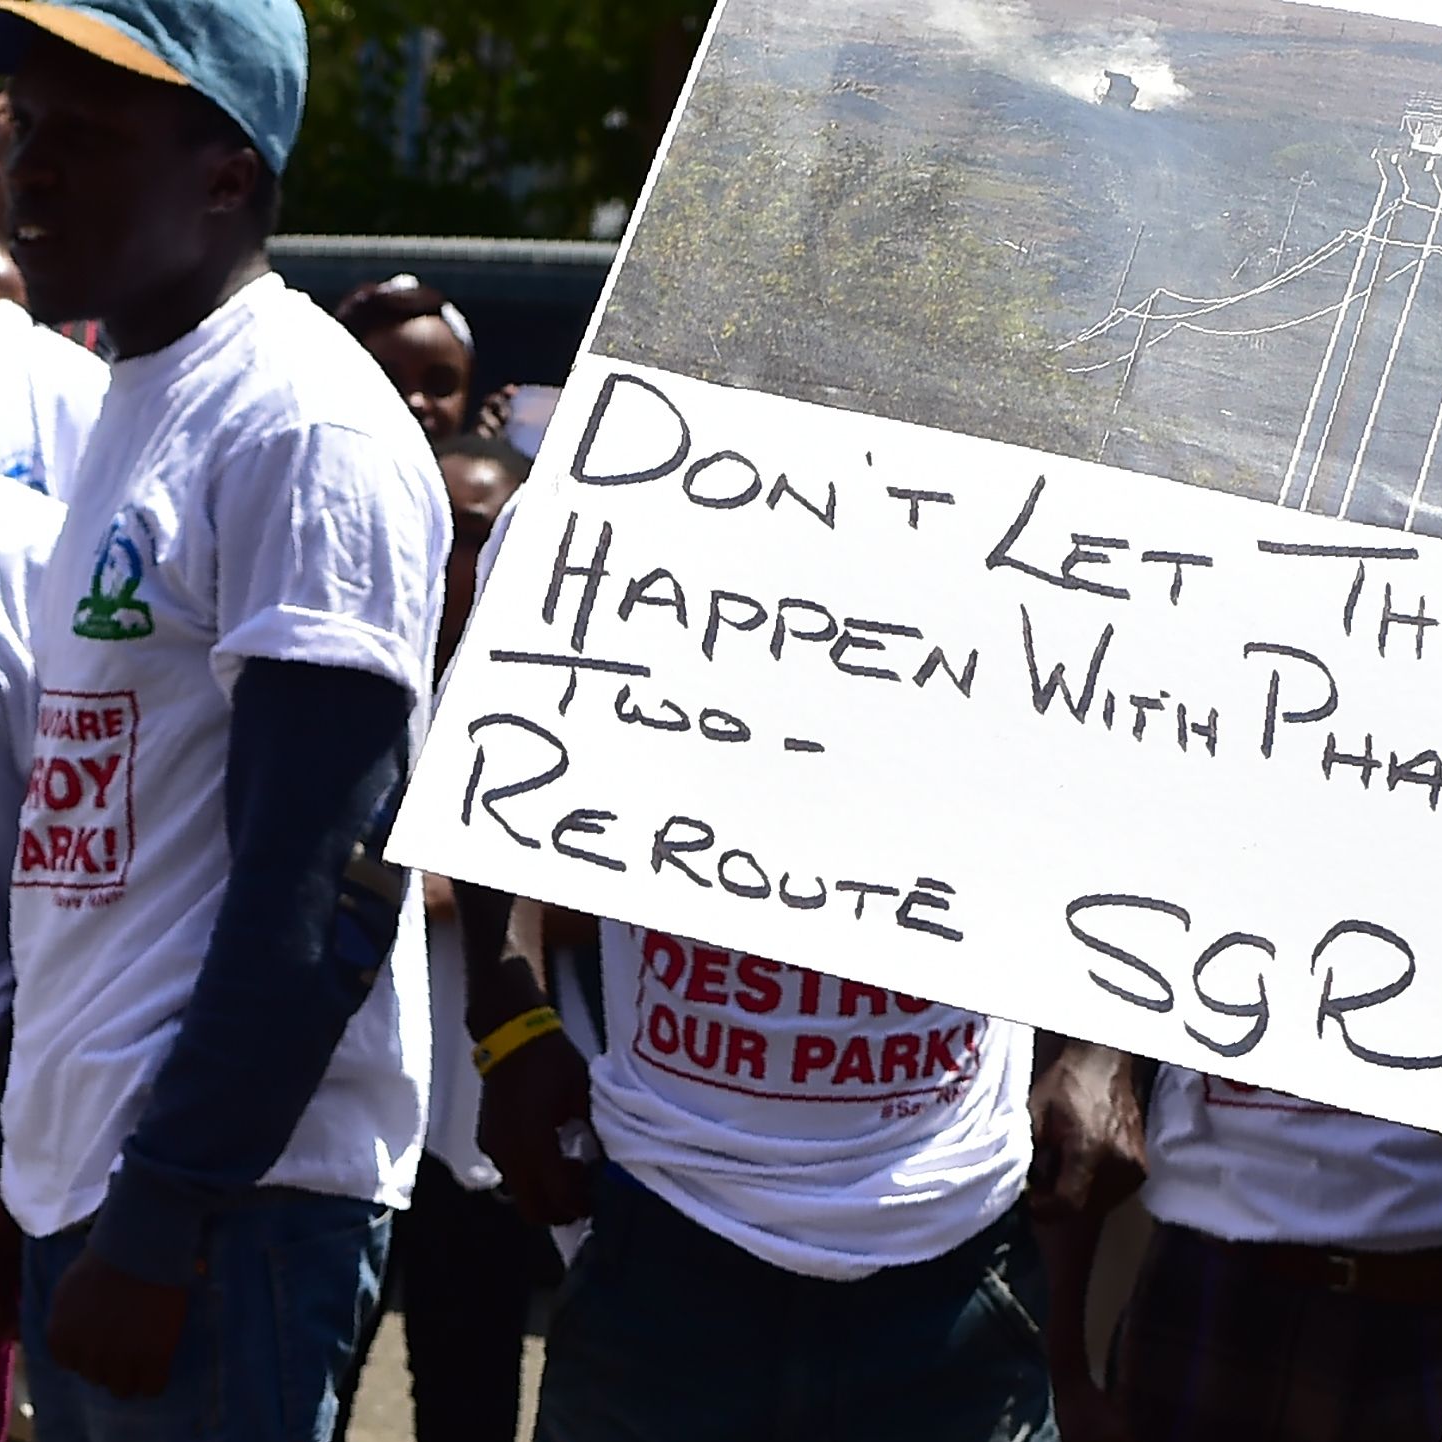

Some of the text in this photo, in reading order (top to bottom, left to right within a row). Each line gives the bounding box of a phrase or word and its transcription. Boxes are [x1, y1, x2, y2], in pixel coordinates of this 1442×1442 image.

[569, 372, 956, 531] DON'T
[984, 474, 1214, 607] LET
[541, 510, 979, 699] HAPPEN
[1019, 603, 1219, 758] WITH
[460, 712, 964, 943] REROUTE
[642, 926, 932, 1018] DESTR
[648, 1002, 975, 1086] OUR PARK!
